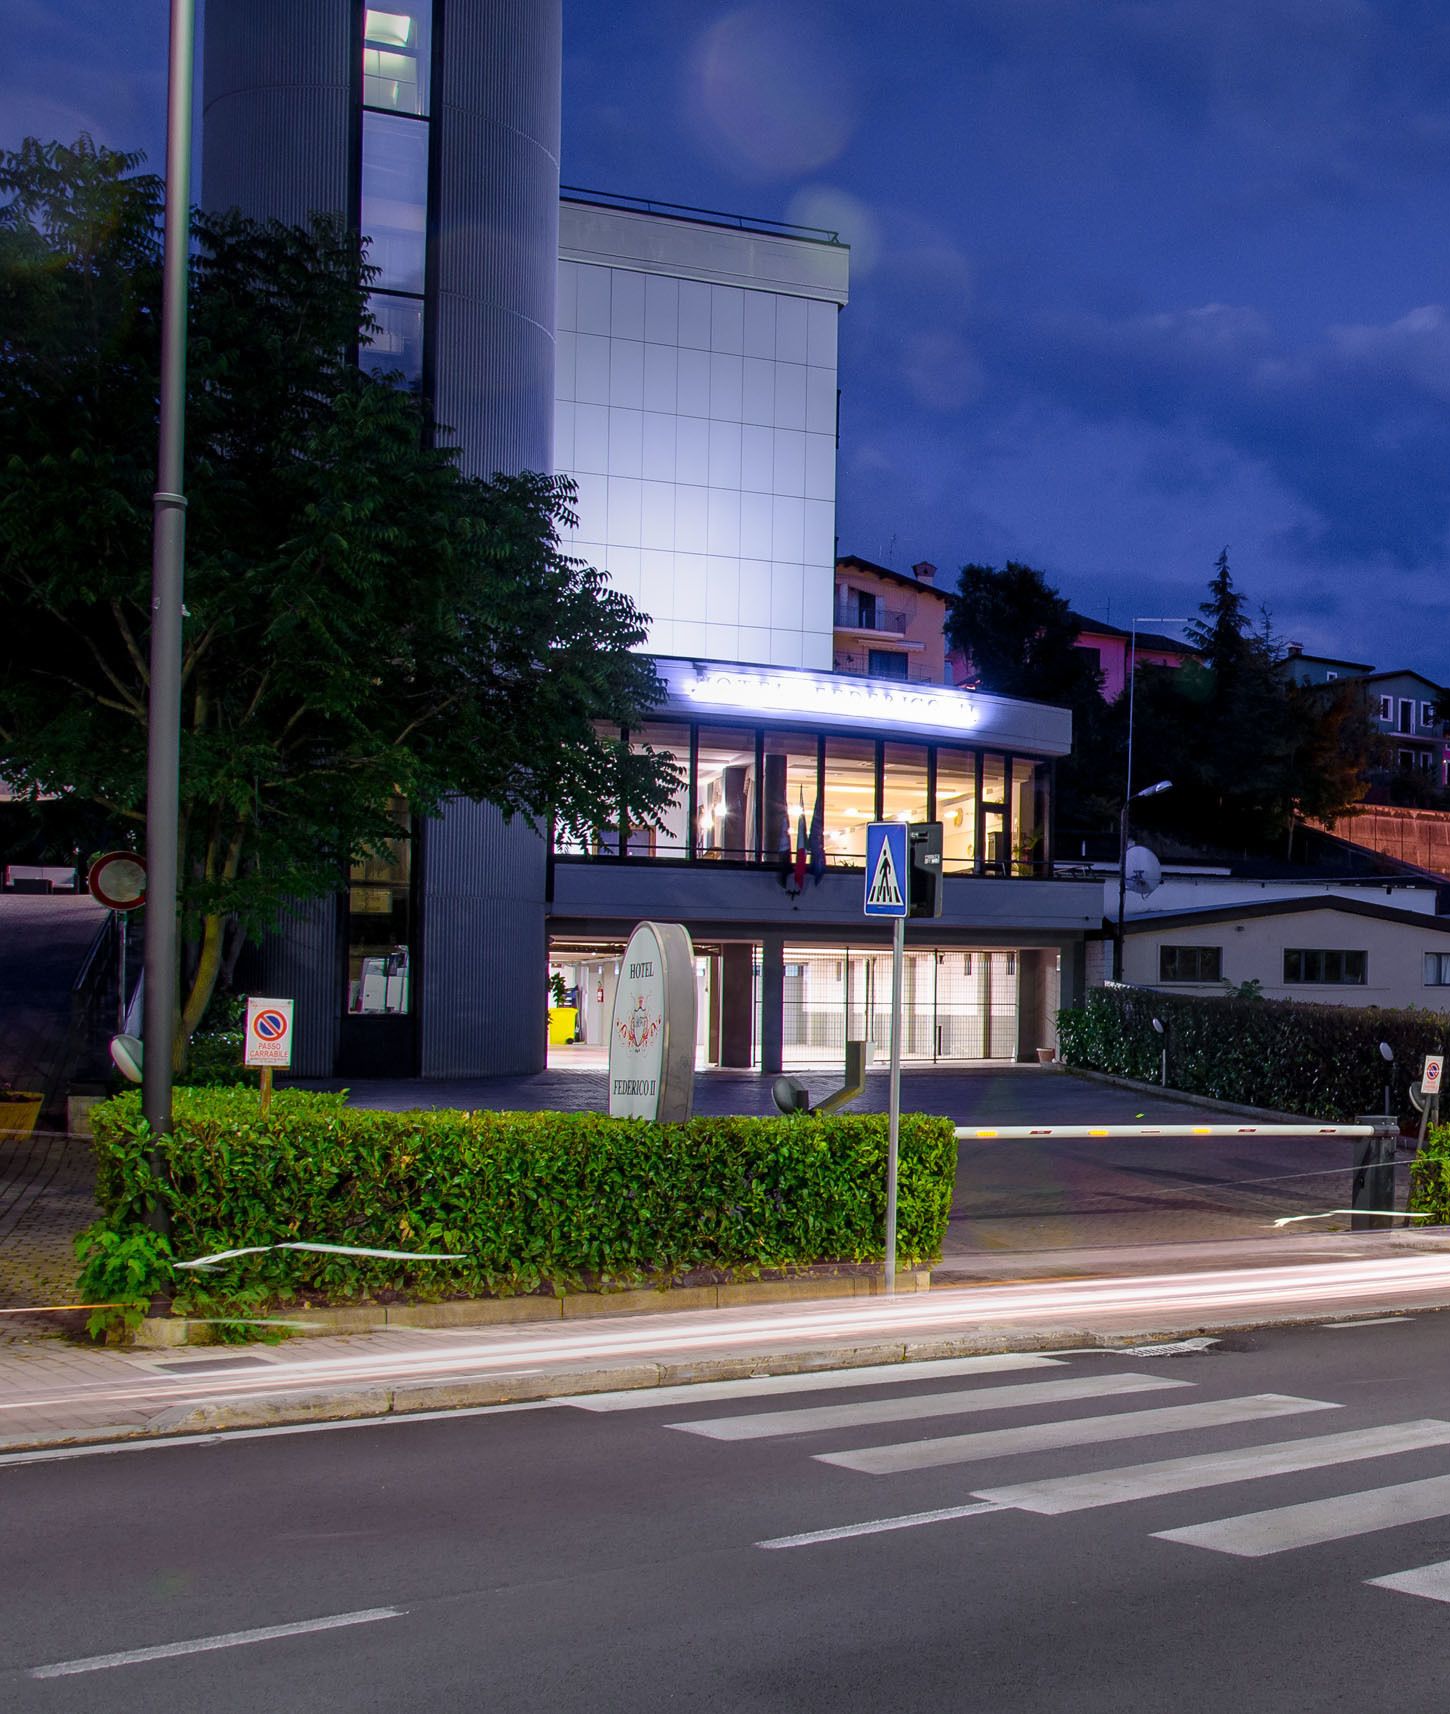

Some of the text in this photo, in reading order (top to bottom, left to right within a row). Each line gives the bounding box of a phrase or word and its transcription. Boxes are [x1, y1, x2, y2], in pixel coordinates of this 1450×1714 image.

[630, 961, 654, 979] HOTEL
[614, 1079, 656, 1096] FEDERICO II
